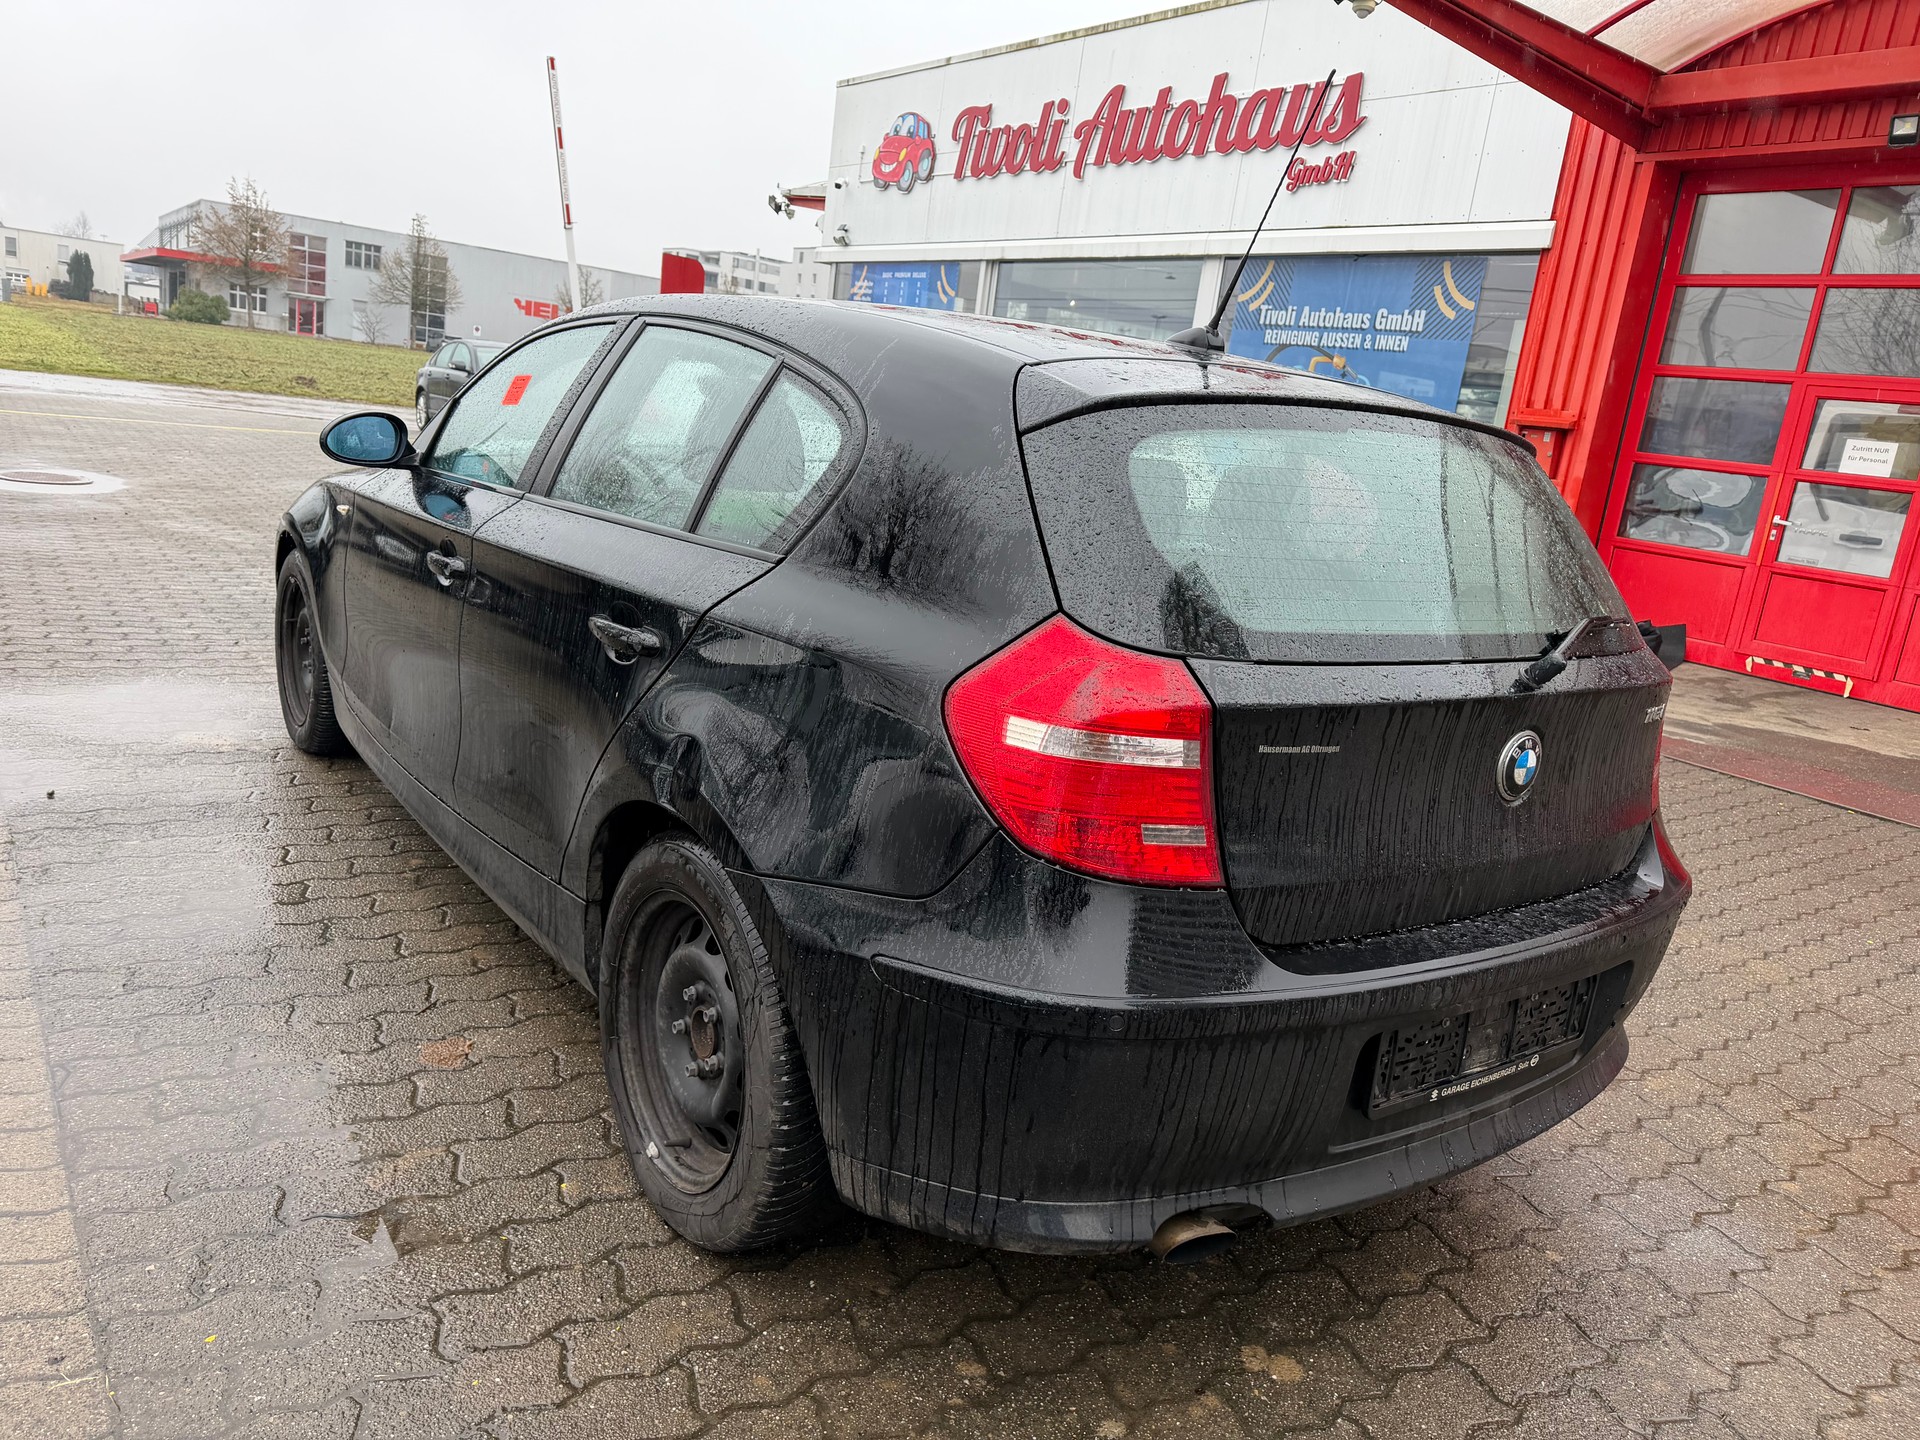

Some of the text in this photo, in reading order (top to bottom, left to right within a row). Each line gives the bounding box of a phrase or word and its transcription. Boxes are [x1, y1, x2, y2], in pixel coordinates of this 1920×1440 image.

[951, 71, 1368, 181] Tivoli Autohaus
[1285, 150, 1357, 195] GmbH
[1258, 304, 1426, 333] Tivoli Autohaus GmbH
[1264, 329, 1409, 352] REINIGUNG AUSSEN & INNEN
[1851, 445, 1873, 453] Zutritt
[1858, 456, 1889, 464] Personal
[1258, 744, 1301, 753] Häusermann
[1301, 745, 1311, 753] AG
[1441, 1081, 1471, 1097] GARAGE
[1470, 1065, 1517, 1088] EICHENBERGER
